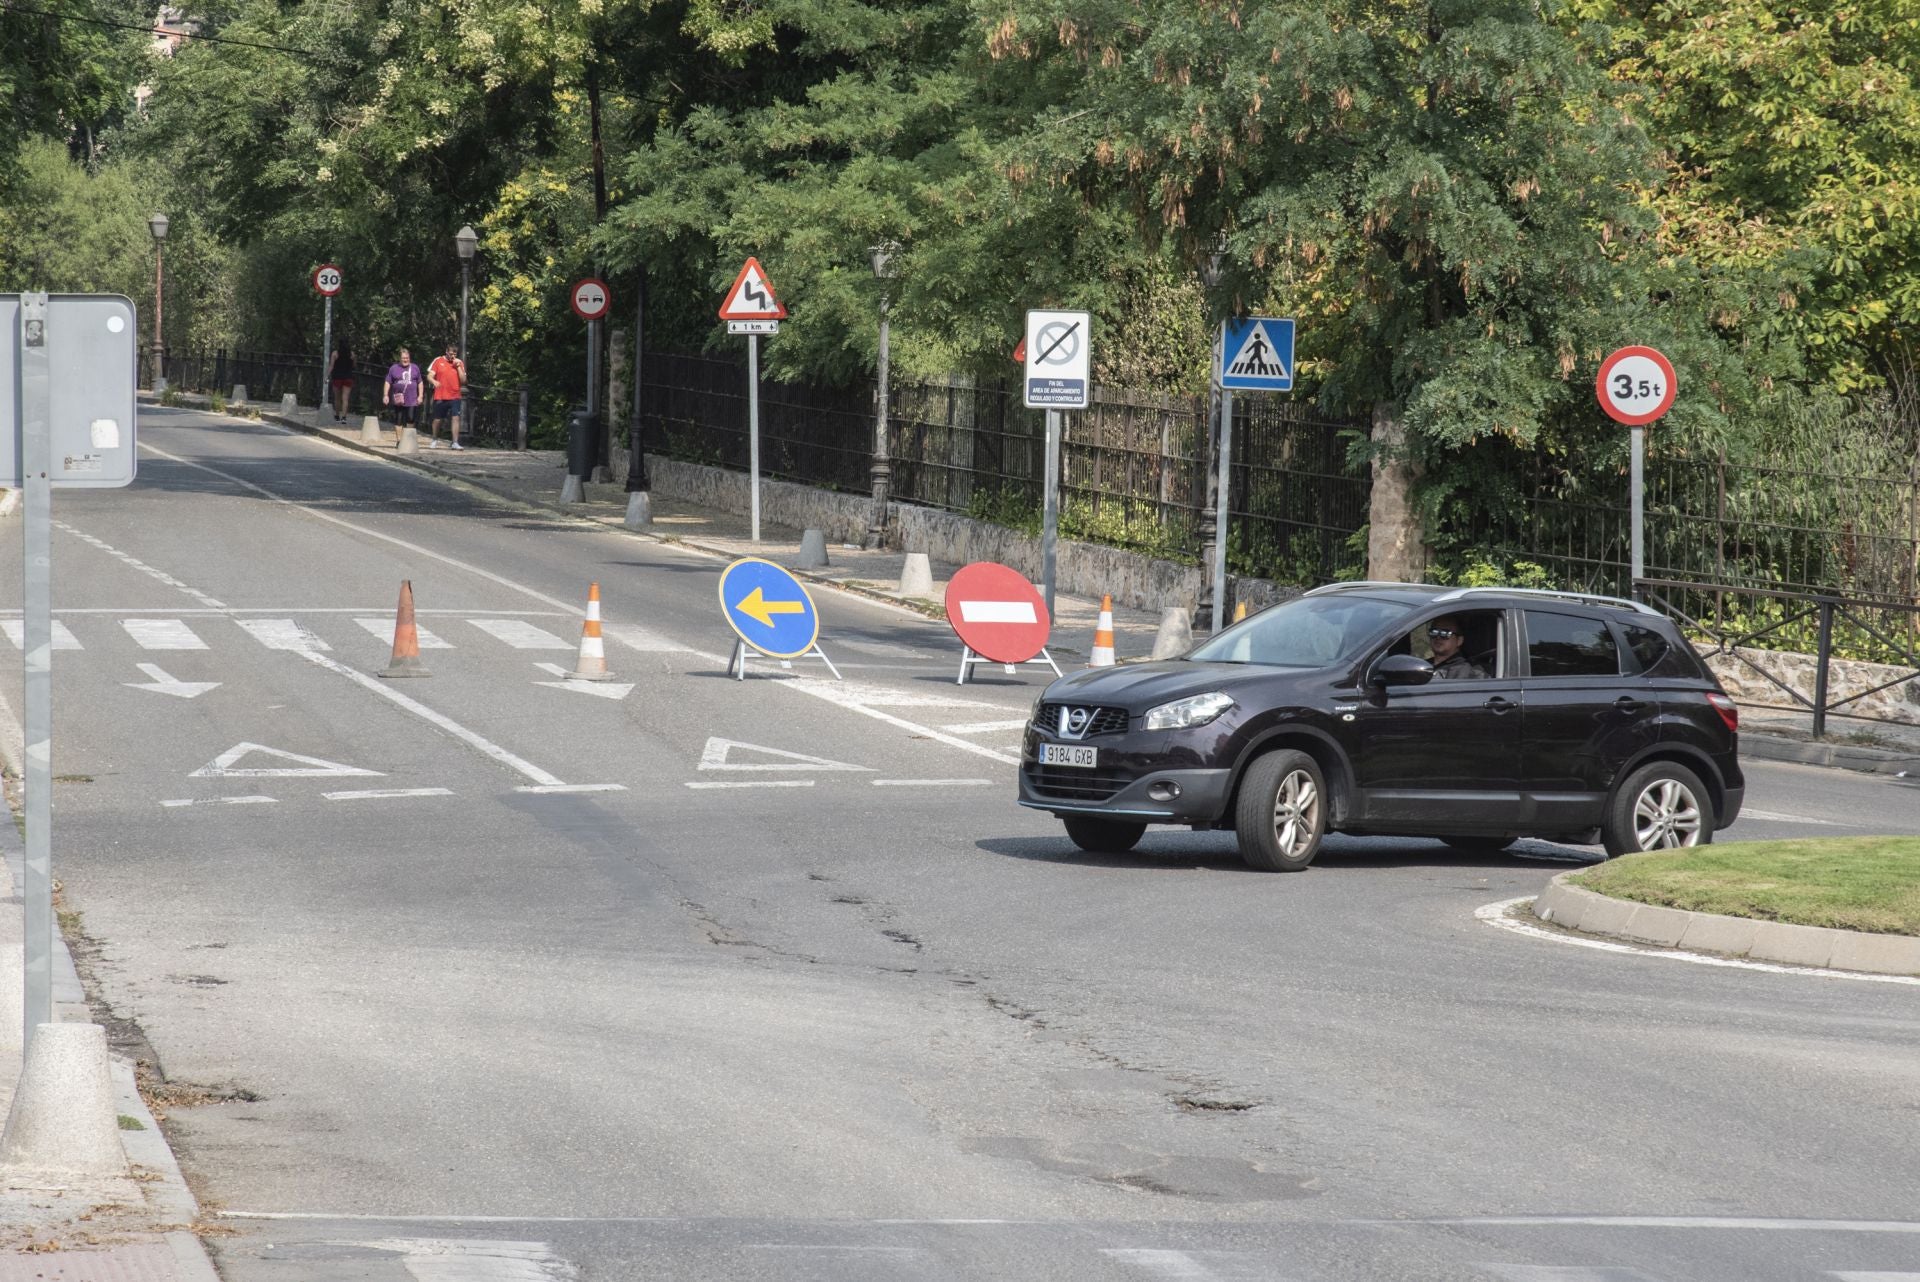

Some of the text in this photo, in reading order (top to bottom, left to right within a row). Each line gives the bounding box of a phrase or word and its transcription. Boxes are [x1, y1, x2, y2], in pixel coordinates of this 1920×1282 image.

[320, 274, 339, 286] 30
[1048, 746, 1093, 765] 9184 GXB
